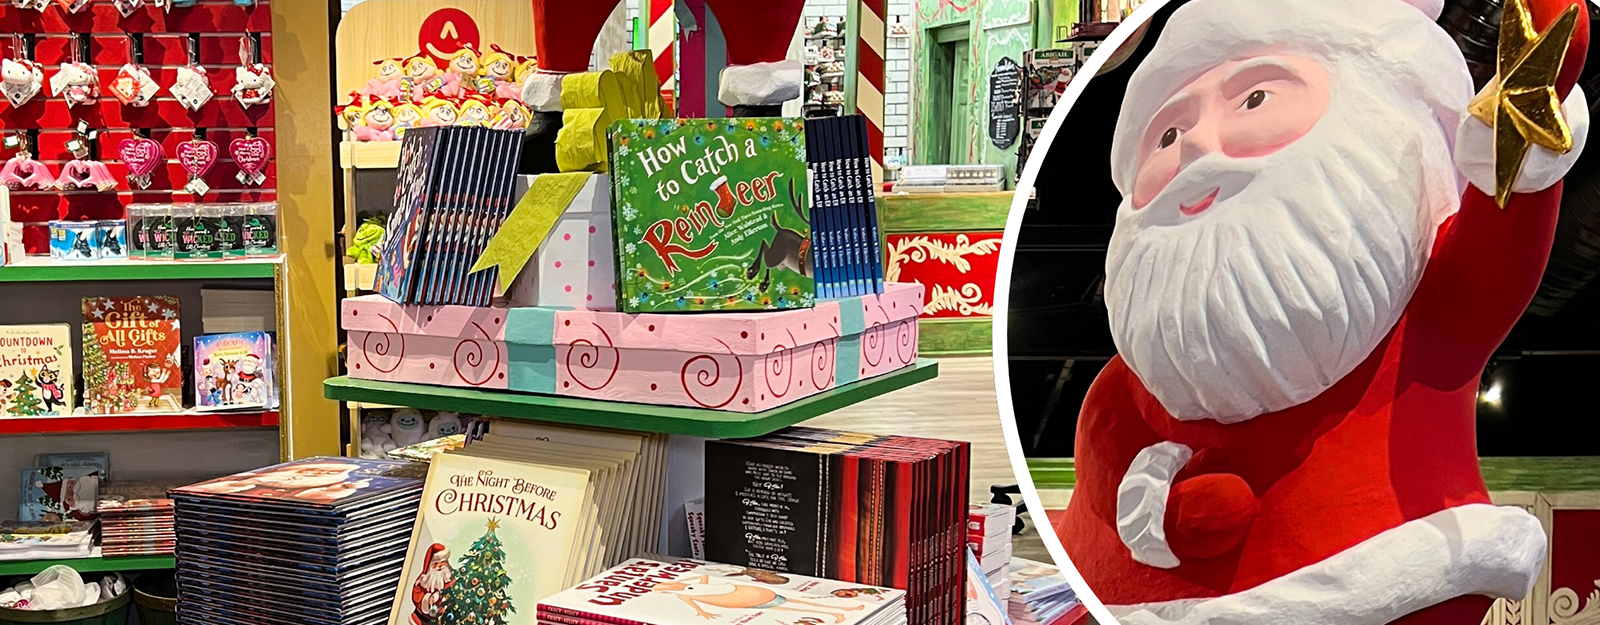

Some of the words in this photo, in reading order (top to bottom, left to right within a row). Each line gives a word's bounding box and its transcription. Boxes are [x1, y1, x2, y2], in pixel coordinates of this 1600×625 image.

[636, 136, 687, 178] How
[655, 179, 680, 201] to
[680, 136, 739, 185] Catch
[744, 138, 758, 158] a
[182, 234, 214, 244] WICKED
[120, 298, 142, 312] The
[105, 312, 148, 329] Gift
[149, 319, 161, 328] of
[0, 337, 53, 347] OUNTDOWN
[100, 330, 126, 348] All
[128, 329, 166, 347] Gifts
[0, 355, 58, 368] hristmas
[688, 512, 697, 538] Squeaky
[575, 561, 661, 593] Santa's
[588, 559, 706, 606] Underwear
